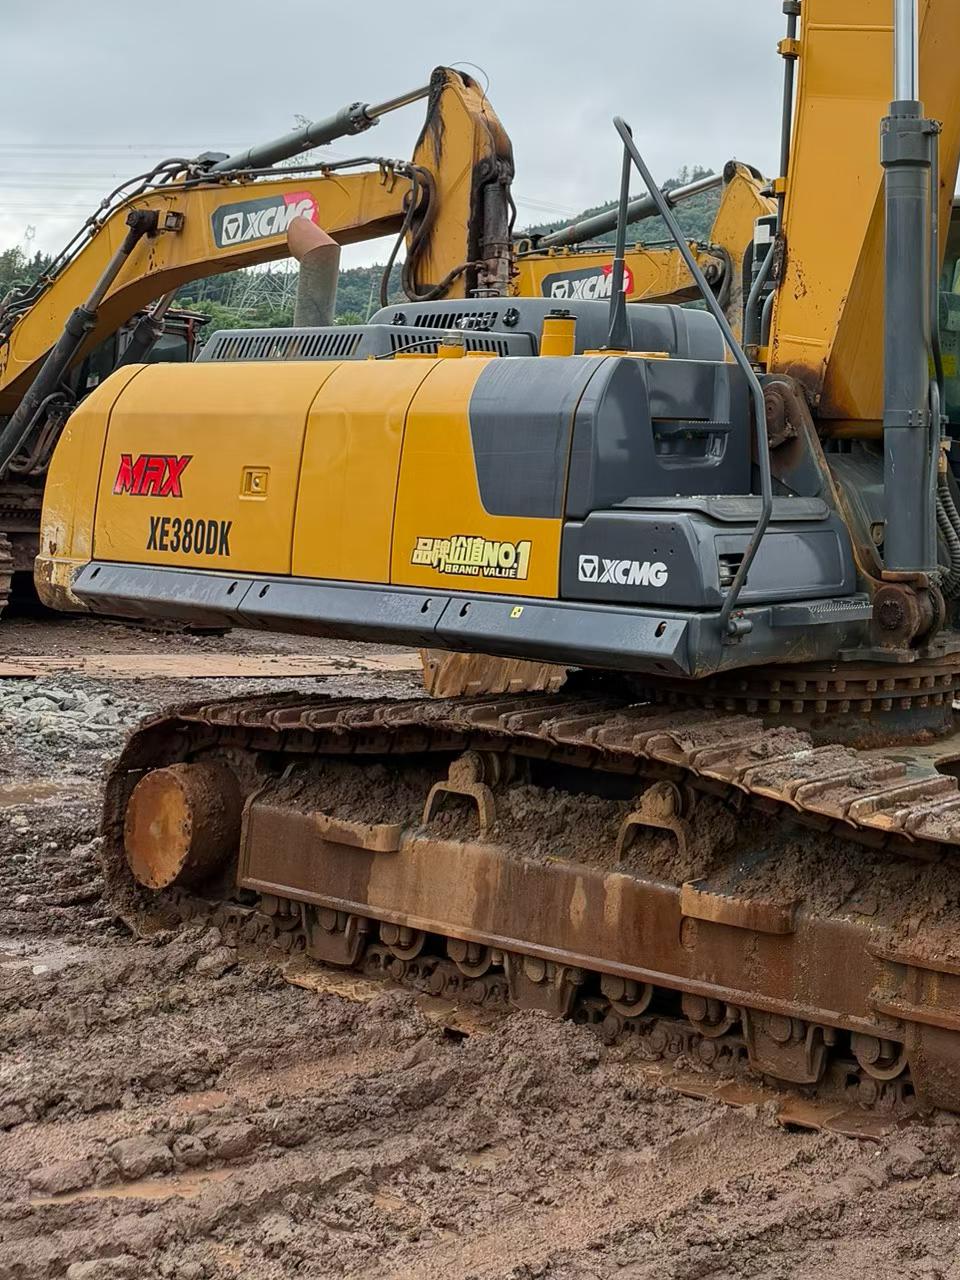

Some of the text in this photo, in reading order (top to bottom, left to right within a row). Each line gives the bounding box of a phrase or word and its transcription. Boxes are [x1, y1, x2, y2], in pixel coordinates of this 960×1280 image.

[112, 453, 194, 498] MAX
[146, 516, 233, 557] XE380DK
[444, 563, 517, 578] BRAND VALUE
[597, 558, 669, 588] XCMG
